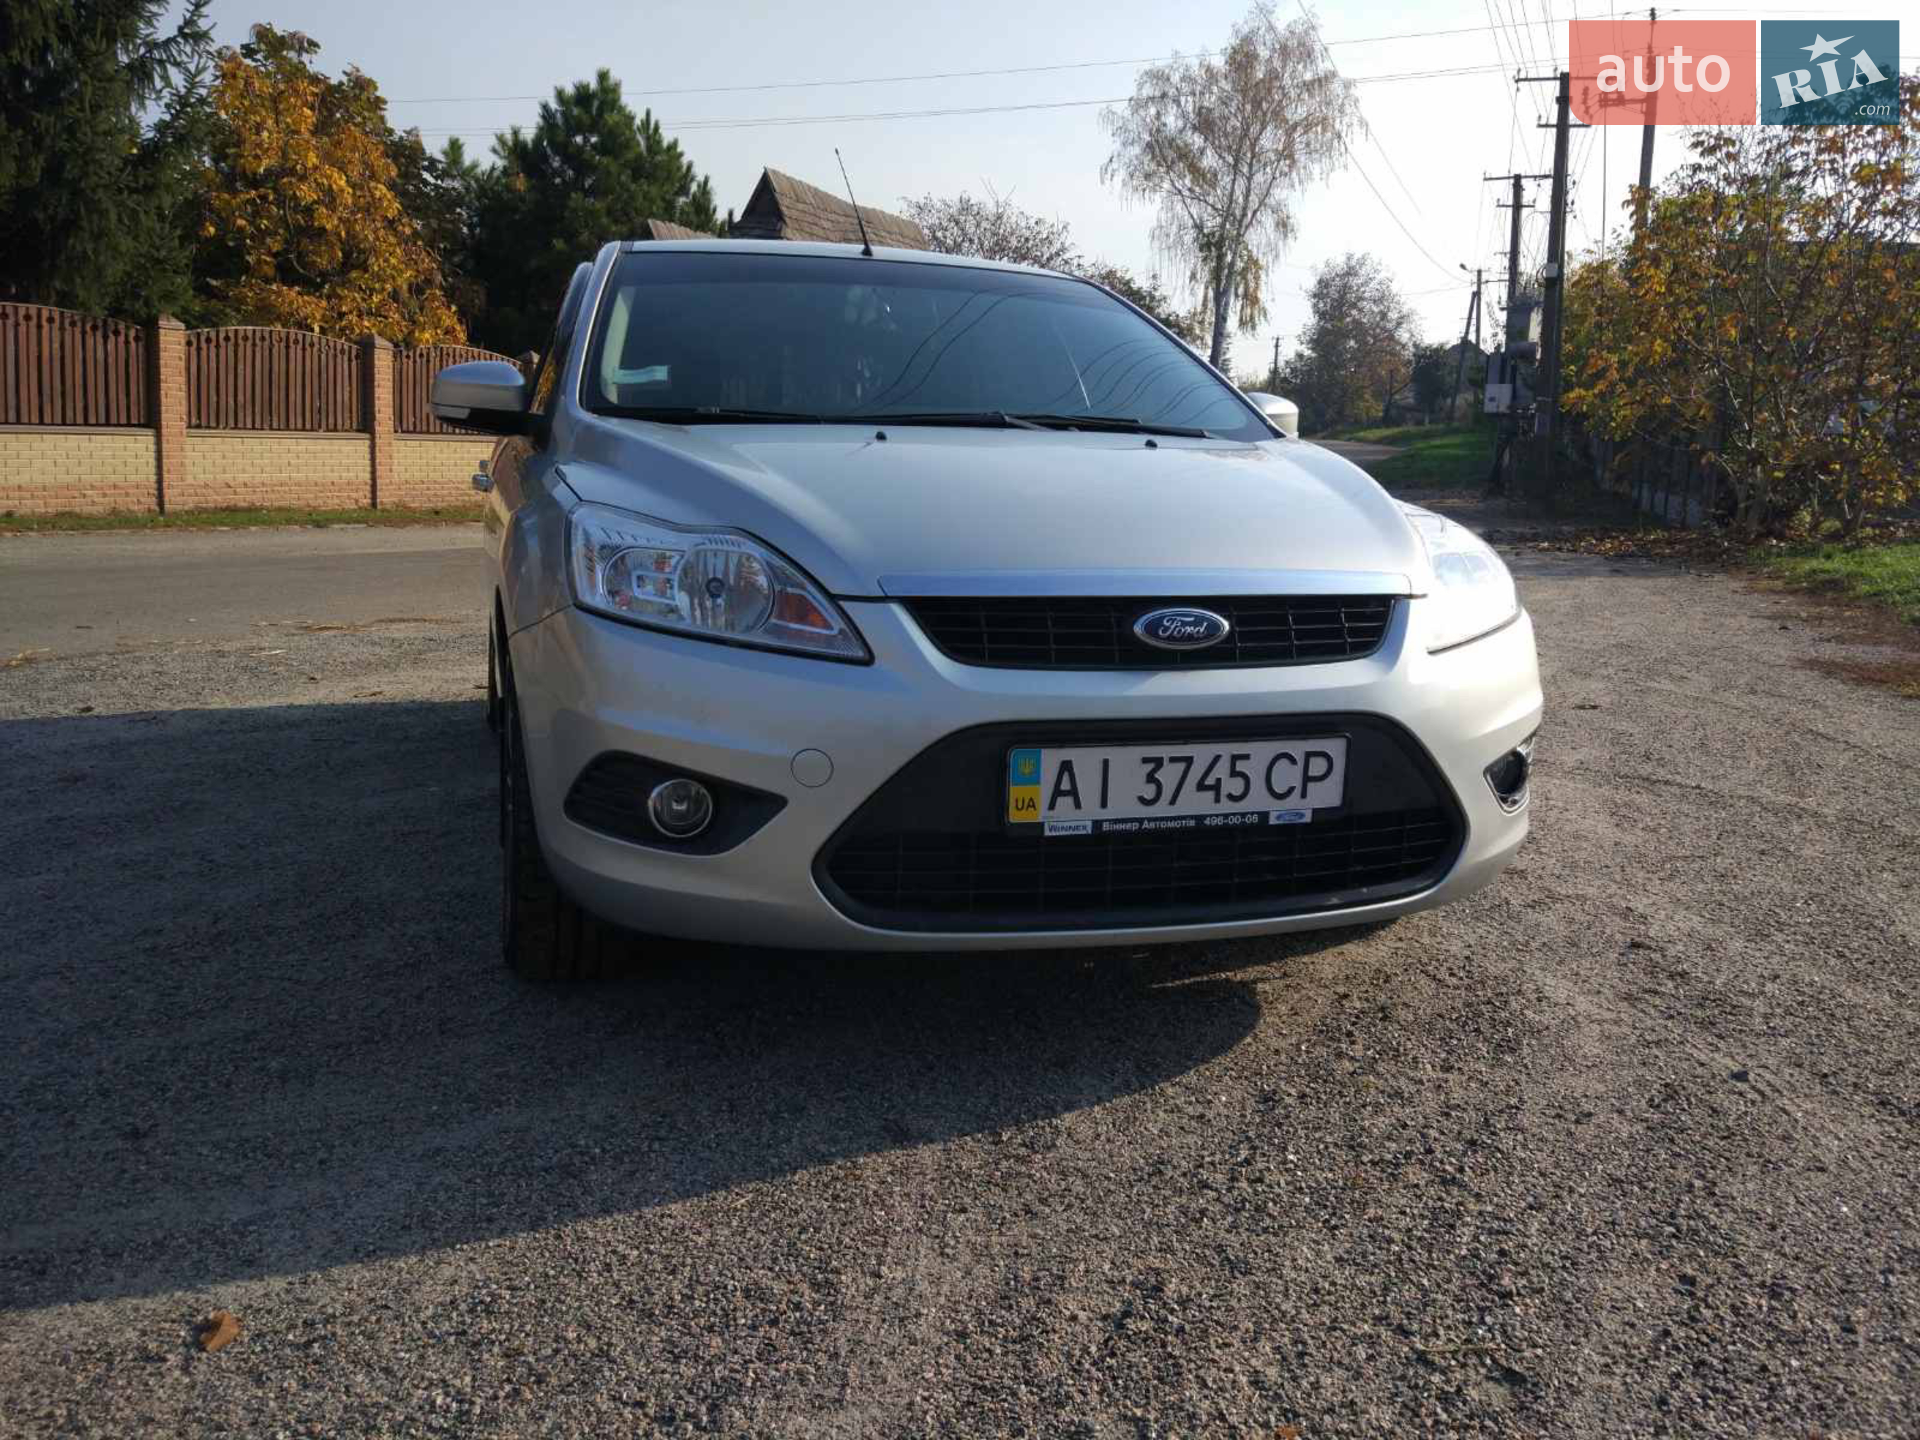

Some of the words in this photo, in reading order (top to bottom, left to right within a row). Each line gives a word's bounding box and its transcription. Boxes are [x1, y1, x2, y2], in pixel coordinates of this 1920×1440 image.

[1159, 616, 1207, 638] Ford
[1137, 754, 1251, 807] 3745
[1015, 796, 1037, 811] UA
